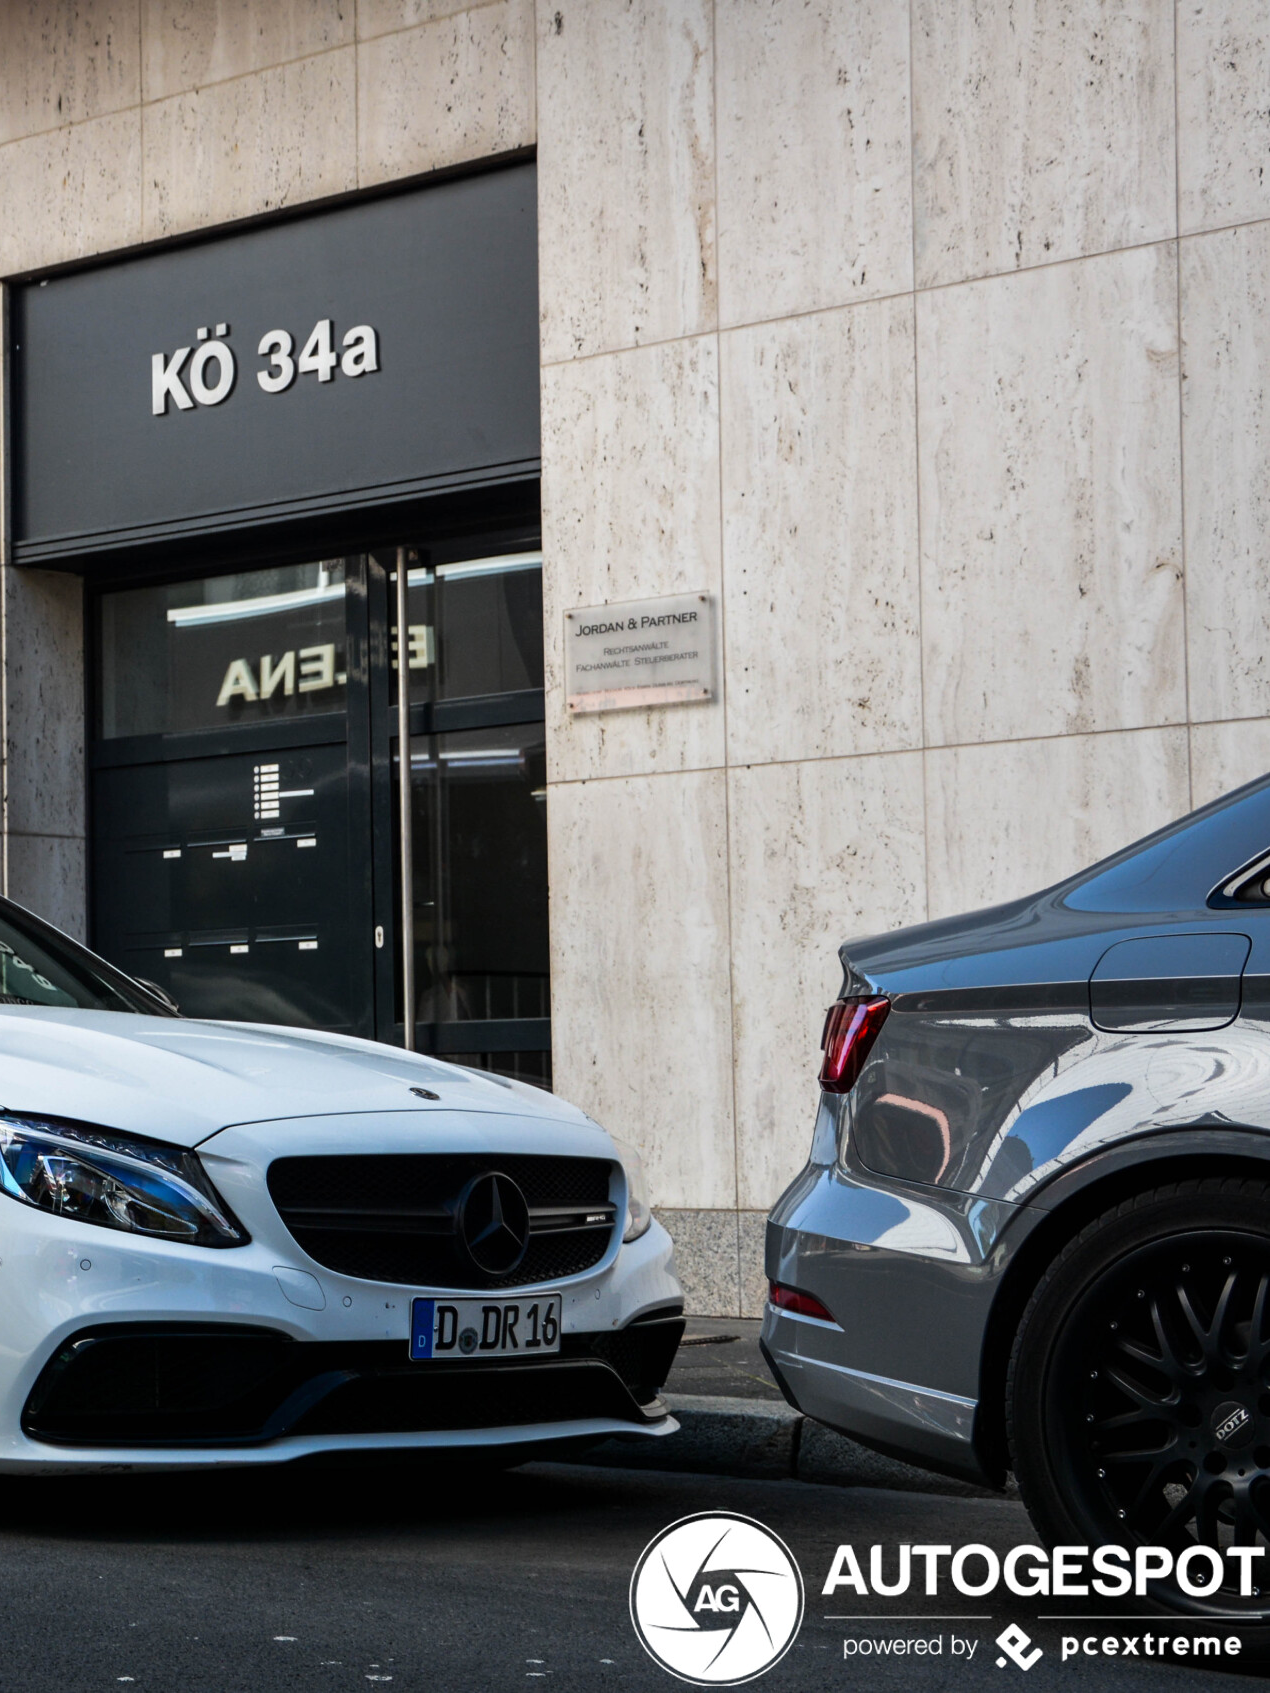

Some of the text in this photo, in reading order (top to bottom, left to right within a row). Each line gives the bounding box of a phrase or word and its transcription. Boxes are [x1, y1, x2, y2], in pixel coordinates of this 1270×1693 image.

[151, 318, 380, 416] KÖ 34a
[575, 611, 698, 637] JORDAN & PARTNER
[418, 1302, 558, 1350] D D DR 16
[1216, 1408, 1249, 1440] DOTZ
